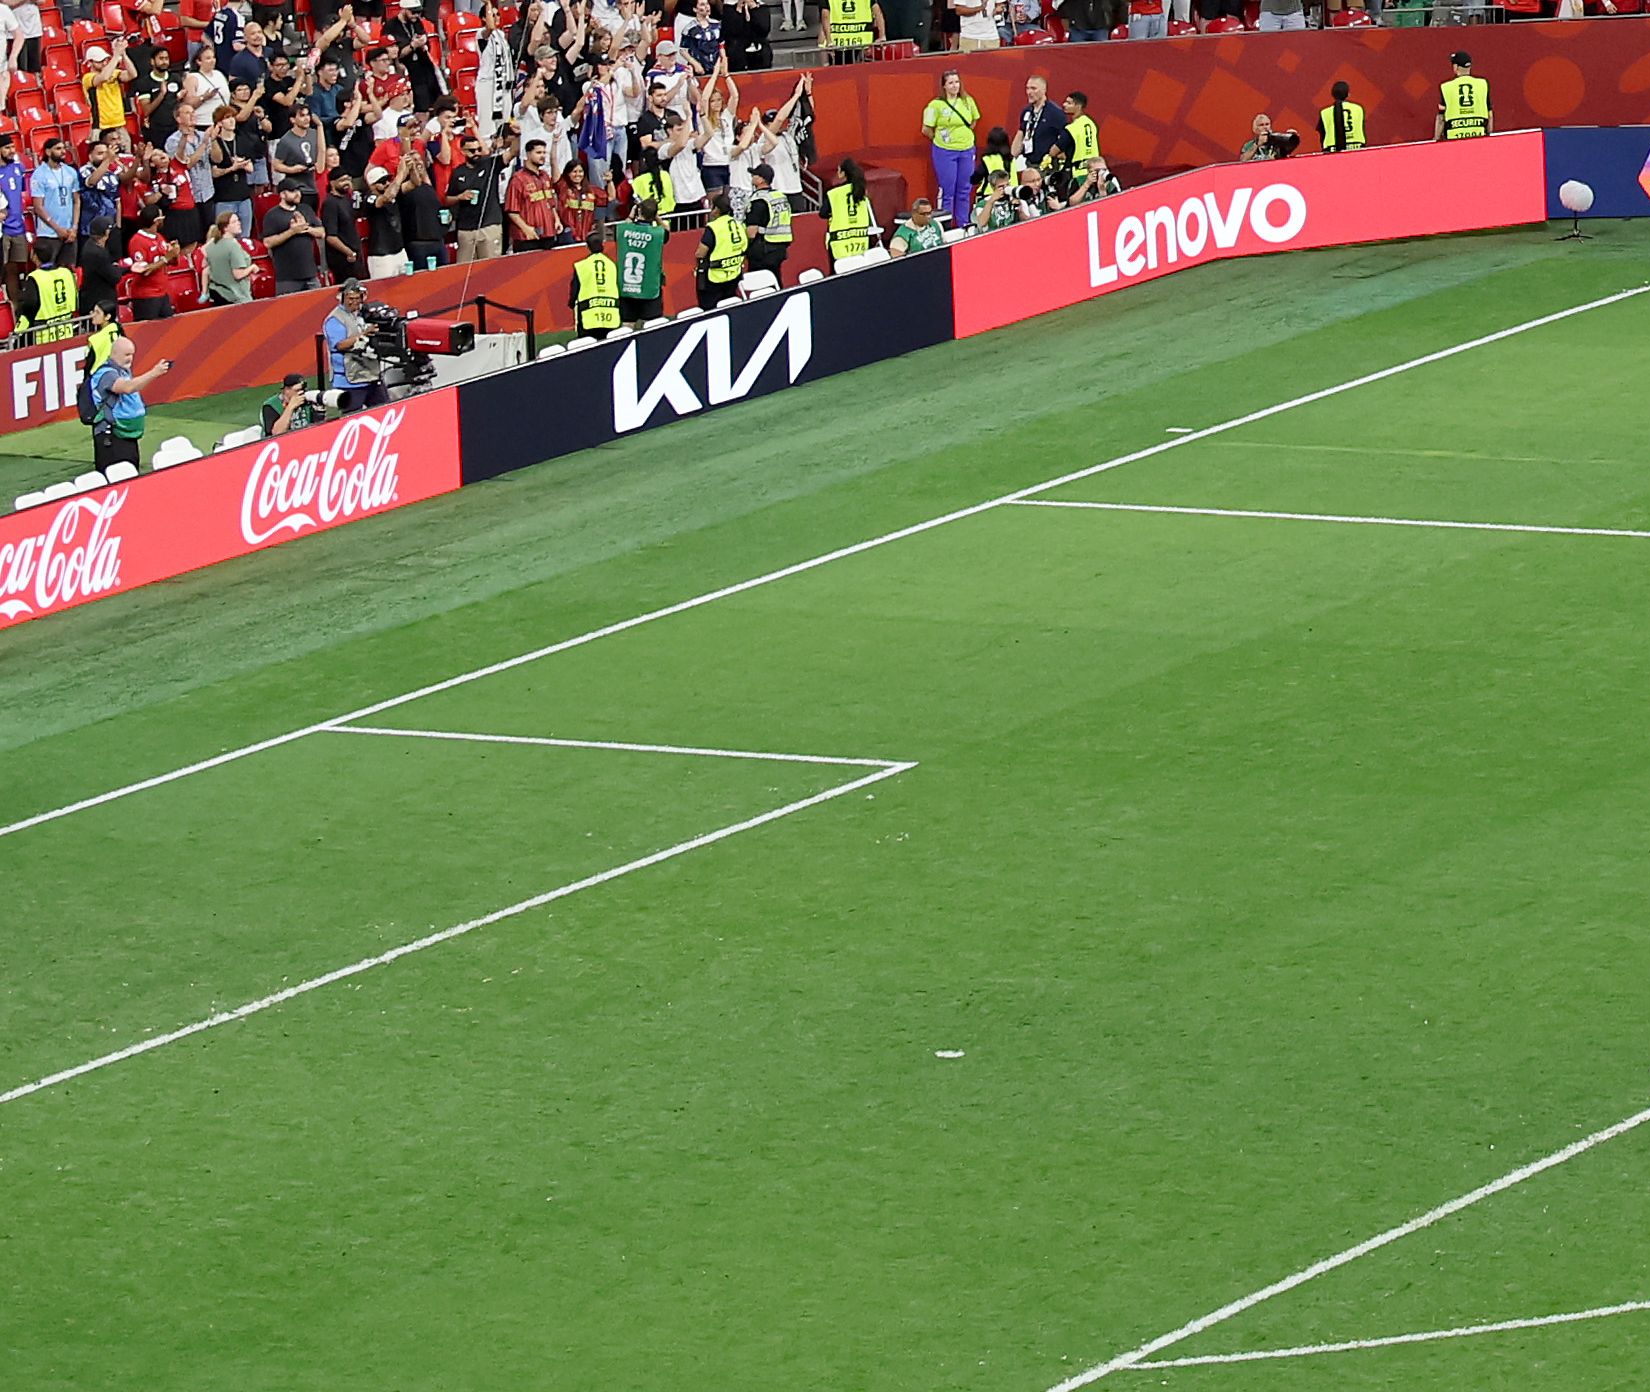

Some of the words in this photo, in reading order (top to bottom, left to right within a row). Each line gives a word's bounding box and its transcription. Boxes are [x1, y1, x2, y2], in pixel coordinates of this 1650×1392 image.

[623, 229, 653, 242] PHOTO
[627, 239, 648, 251] 1477
[1086, 182, 1308, 288] Lenovo
[12, 346, 86, 420] FIF
[611, 291, 813, 433] KIA
[239, 405, 406, 546] Coca-Cola
[0, 486, 129, 620] ca-Cola
